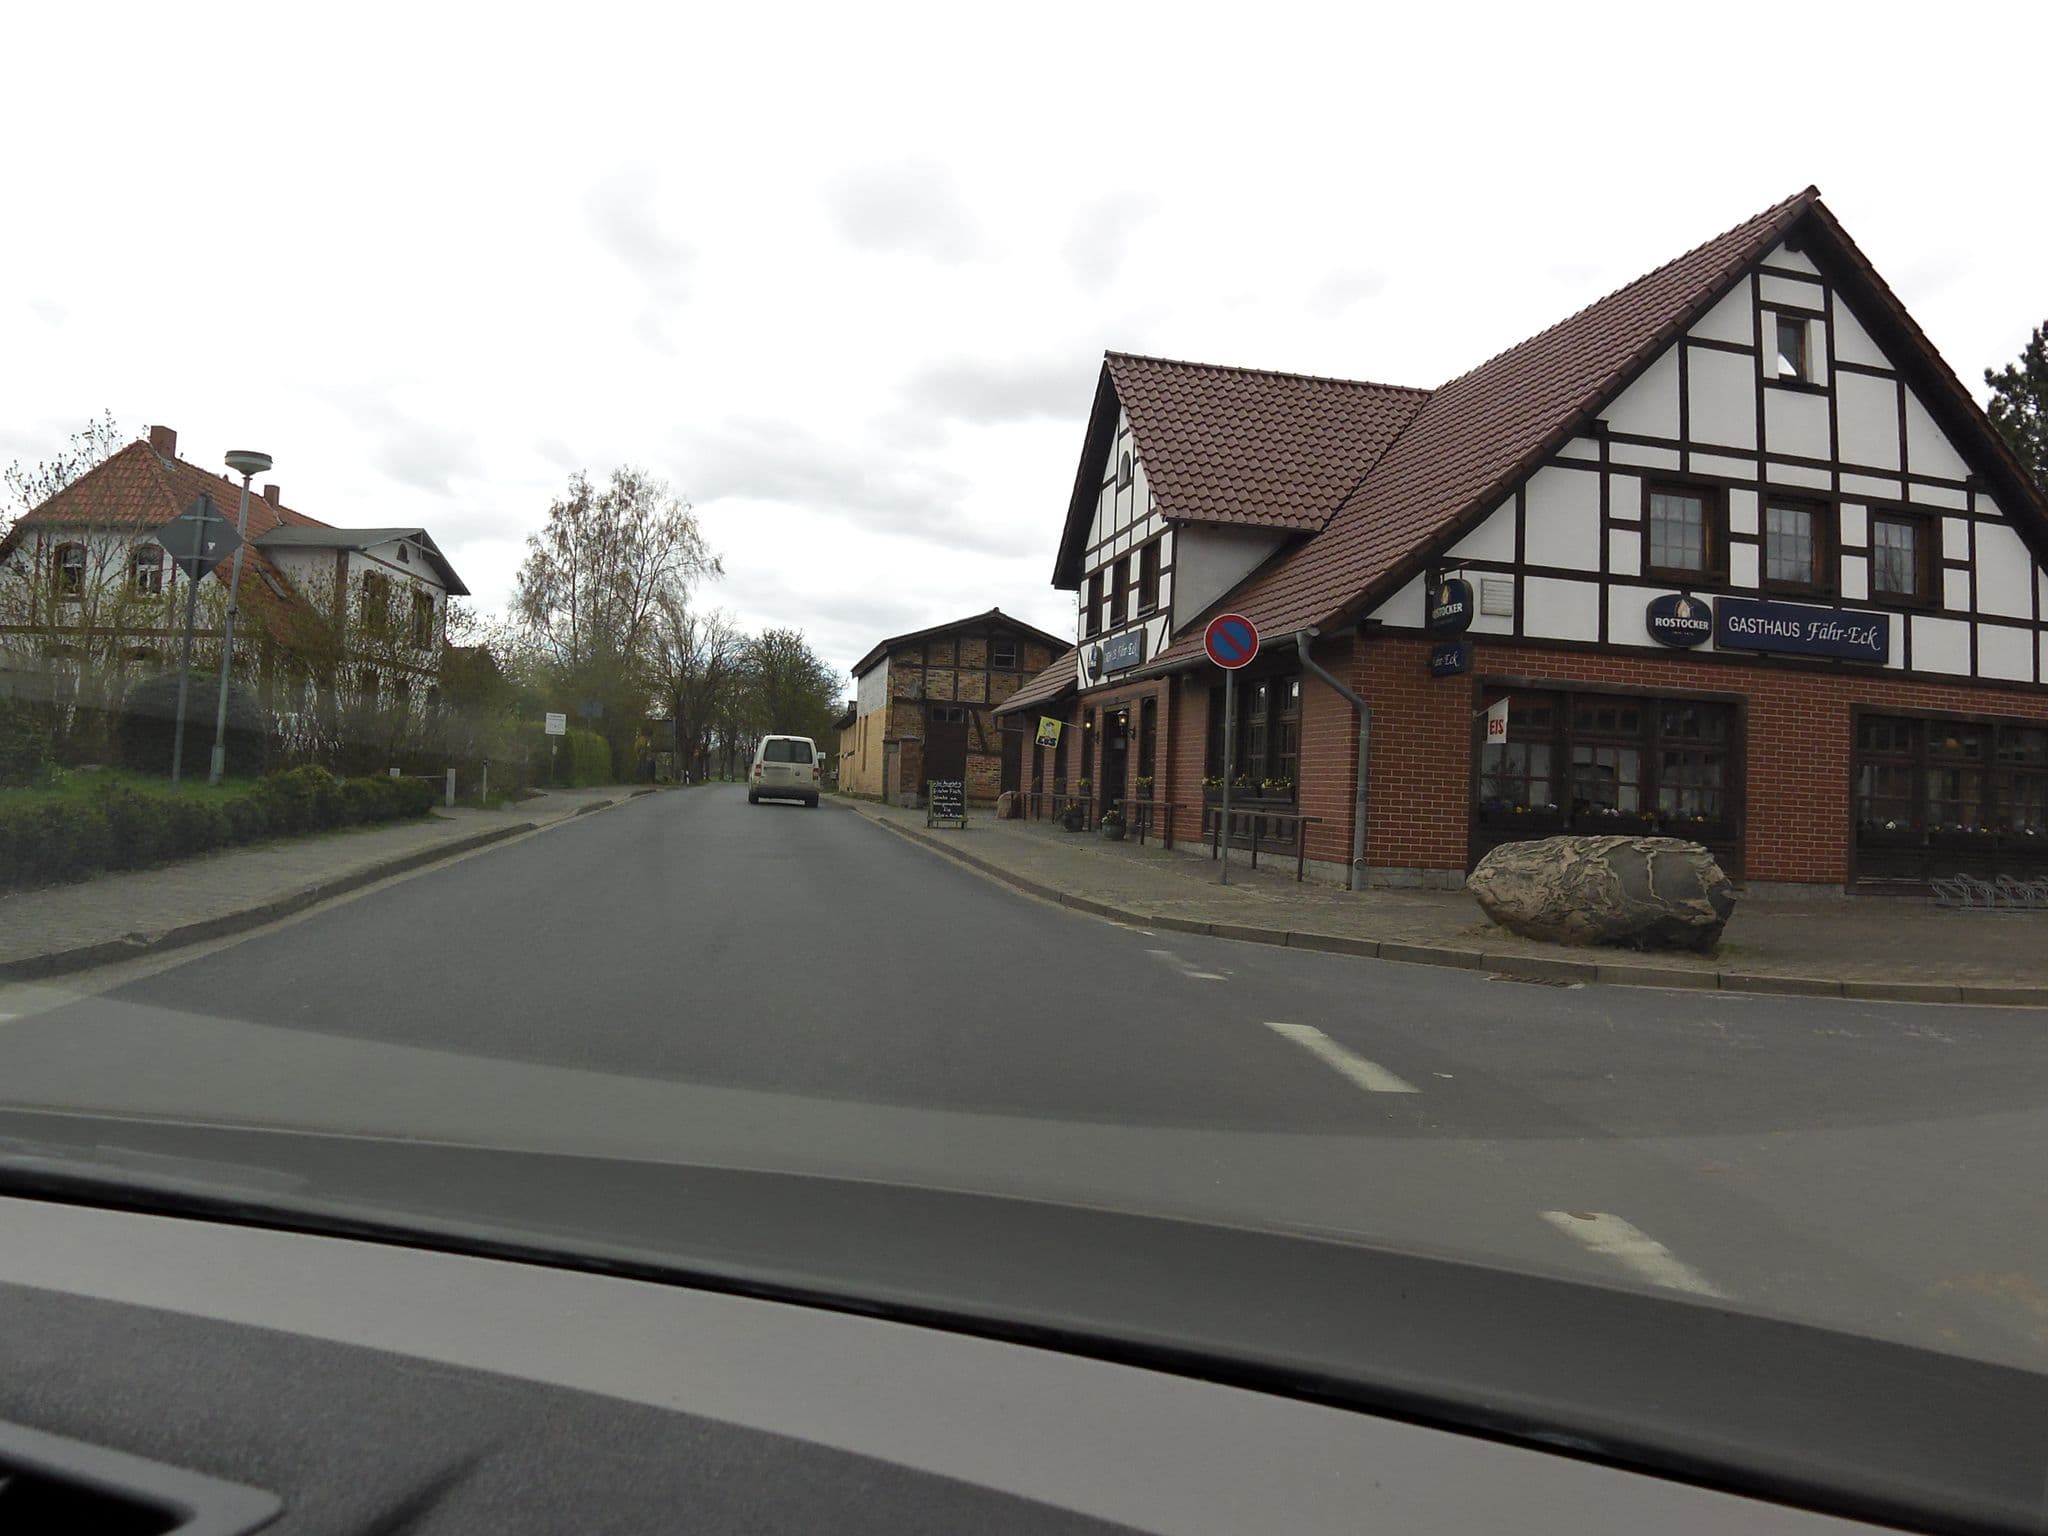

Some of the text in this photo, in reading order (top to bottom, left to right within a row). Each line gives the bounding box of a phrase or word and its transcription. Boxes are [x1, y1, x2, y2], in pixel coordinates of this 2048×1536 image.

[1655, 617, 1709, 631] ROSTOCKER
[1728, 616, 1881, 651] GASTHAUS Fähr-Eck
[1489, 718, 1504, 735] EIS
